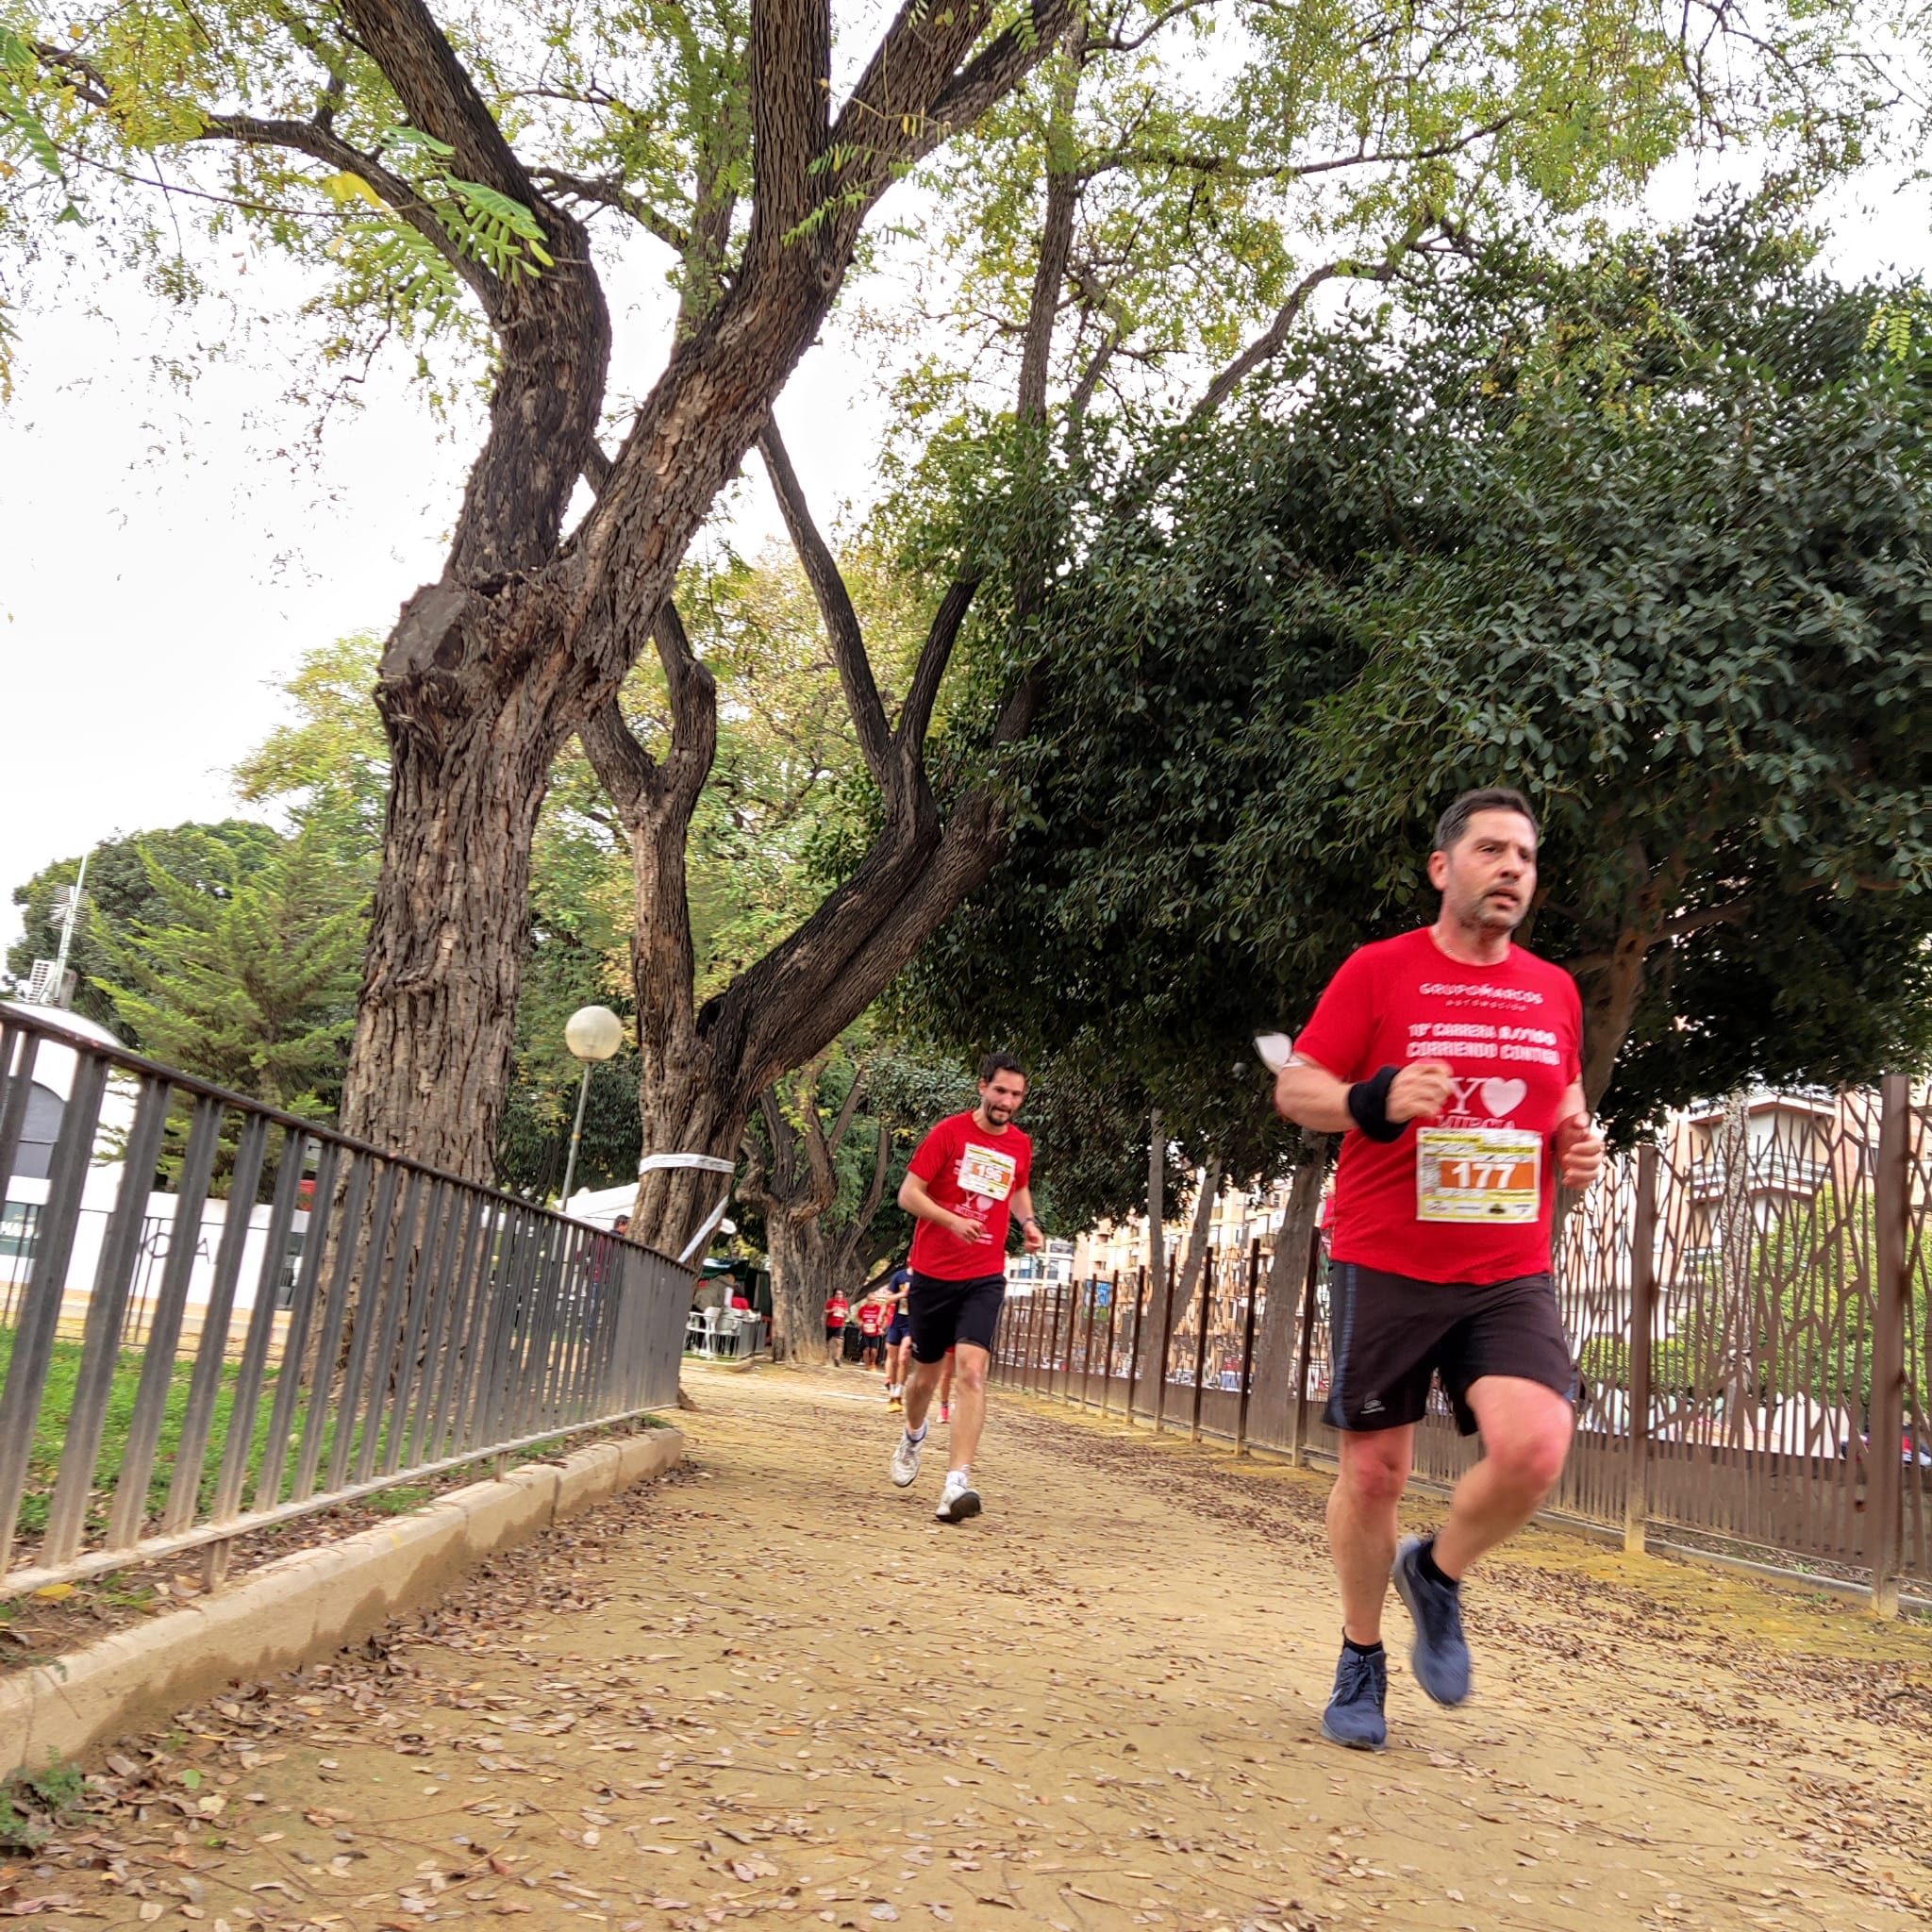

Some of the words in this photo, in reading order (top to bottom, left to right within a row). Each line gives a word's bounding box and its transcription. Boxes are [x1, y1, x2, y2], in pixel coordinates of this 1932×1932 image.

[1406, 1041, 1498, 1059] CORRIENDO
[977, 1163, 1003, 1183] 196
[1451, 1161, 1517, 1190] 177
